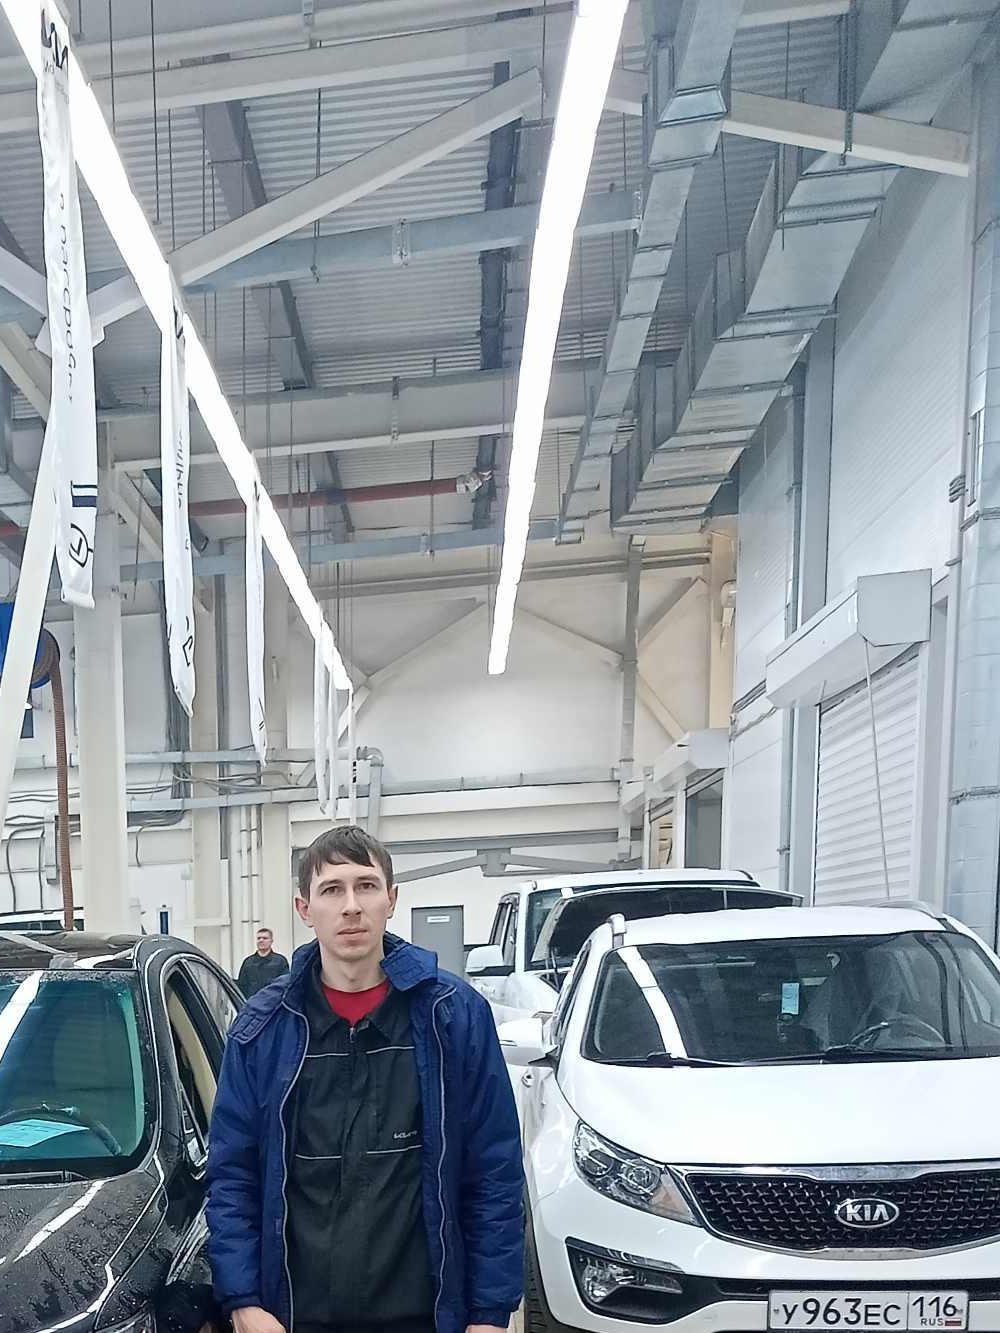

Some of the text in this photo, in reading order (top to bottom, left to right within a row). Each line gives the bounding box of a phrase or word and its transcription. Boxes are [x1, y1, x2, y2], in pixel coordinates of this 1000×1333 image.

[846, 1206, 890, 1221] KIA
[782, 1296, 957, 1326] У963ЕС 116
[920, 1317, 944, 1327] RUS
